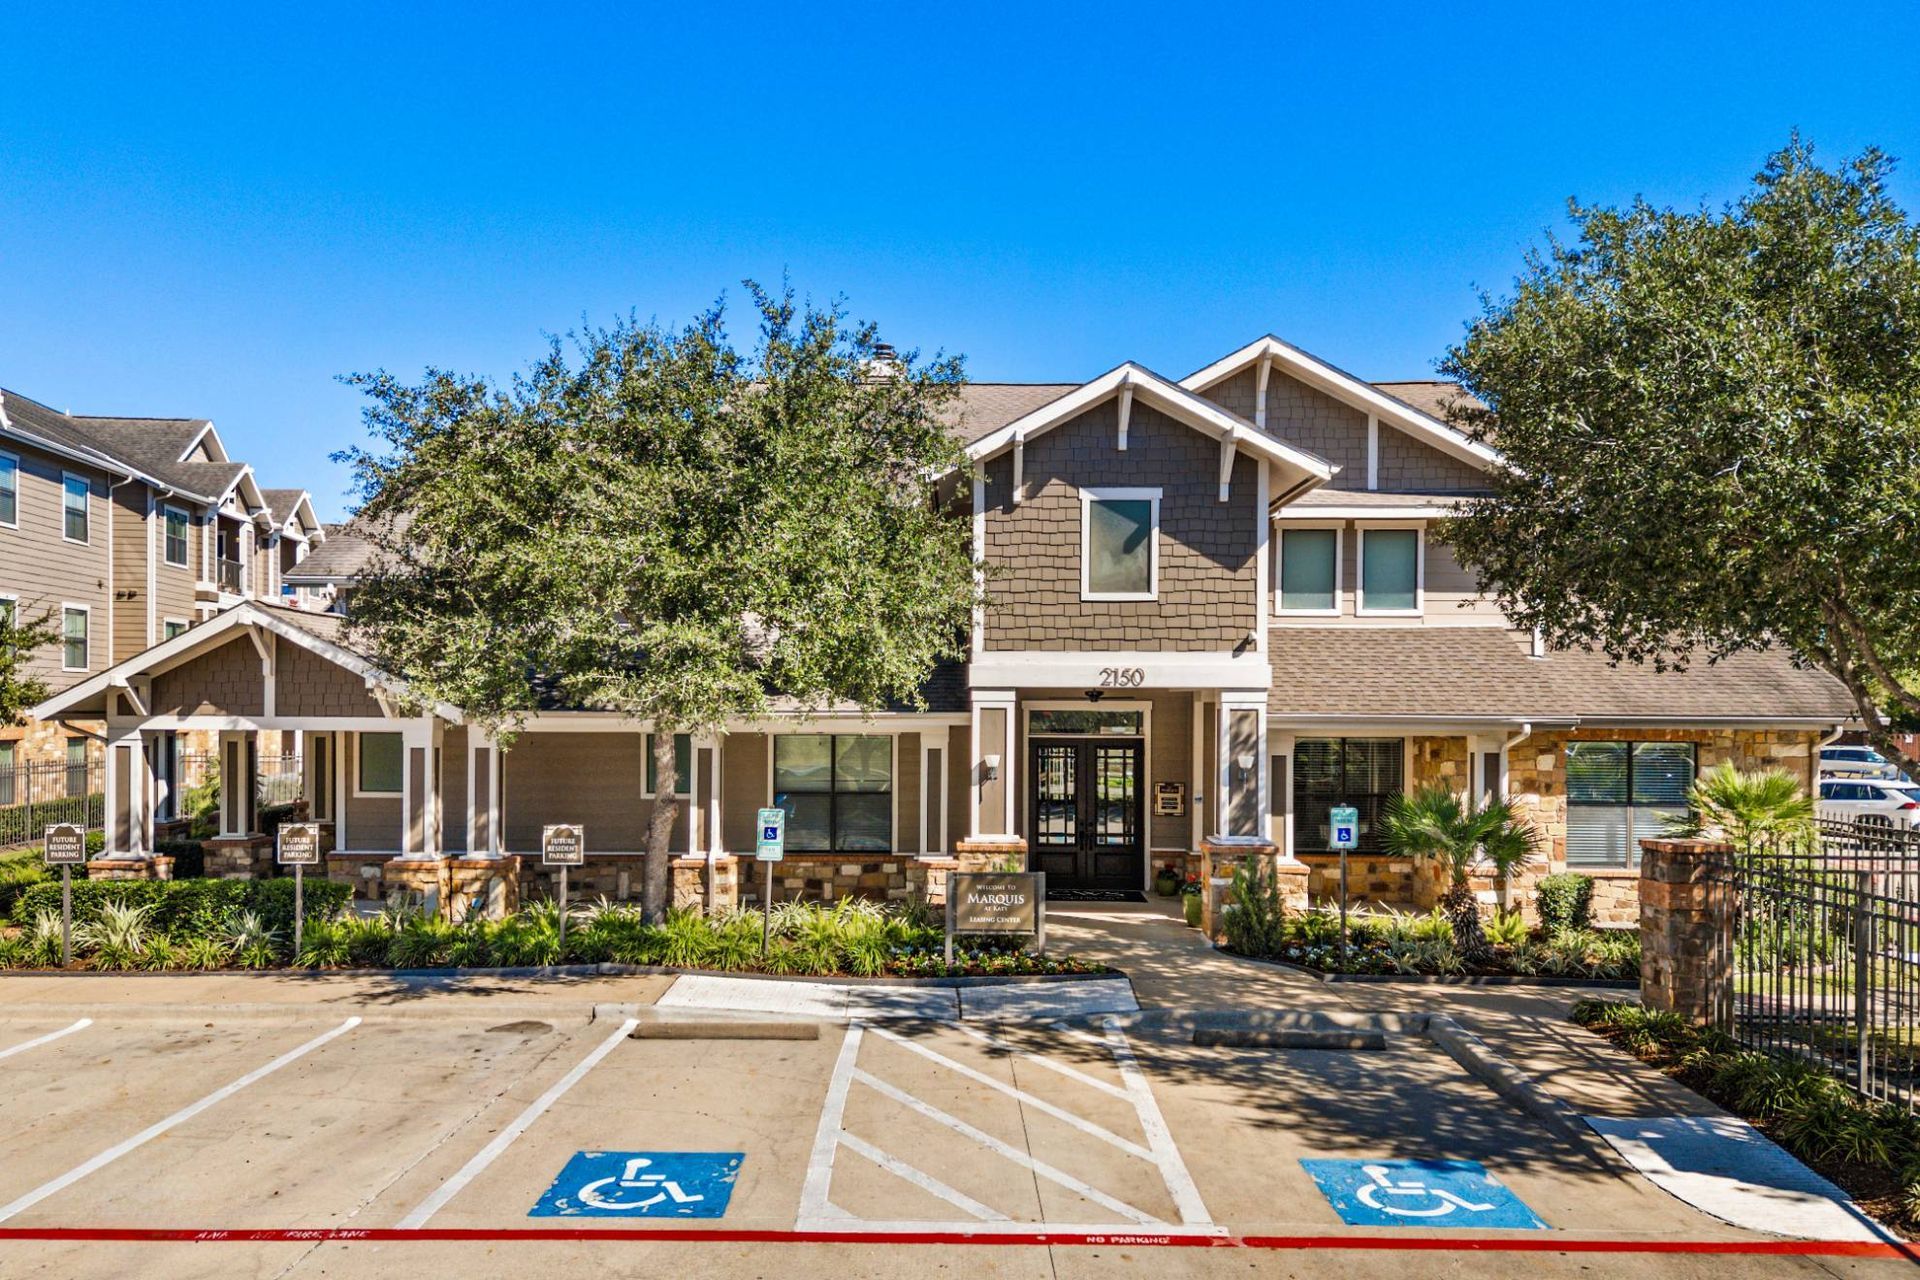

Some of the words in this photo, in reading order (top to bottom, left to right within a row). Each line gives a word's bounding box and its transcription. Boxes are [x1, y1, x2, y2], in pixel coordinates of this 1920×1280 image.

[1099, 667, 1145, 687] 2150
[967, 893, 1025, 906] MARQUIS
[1110, 1236, 1170, 1244] PARKING
